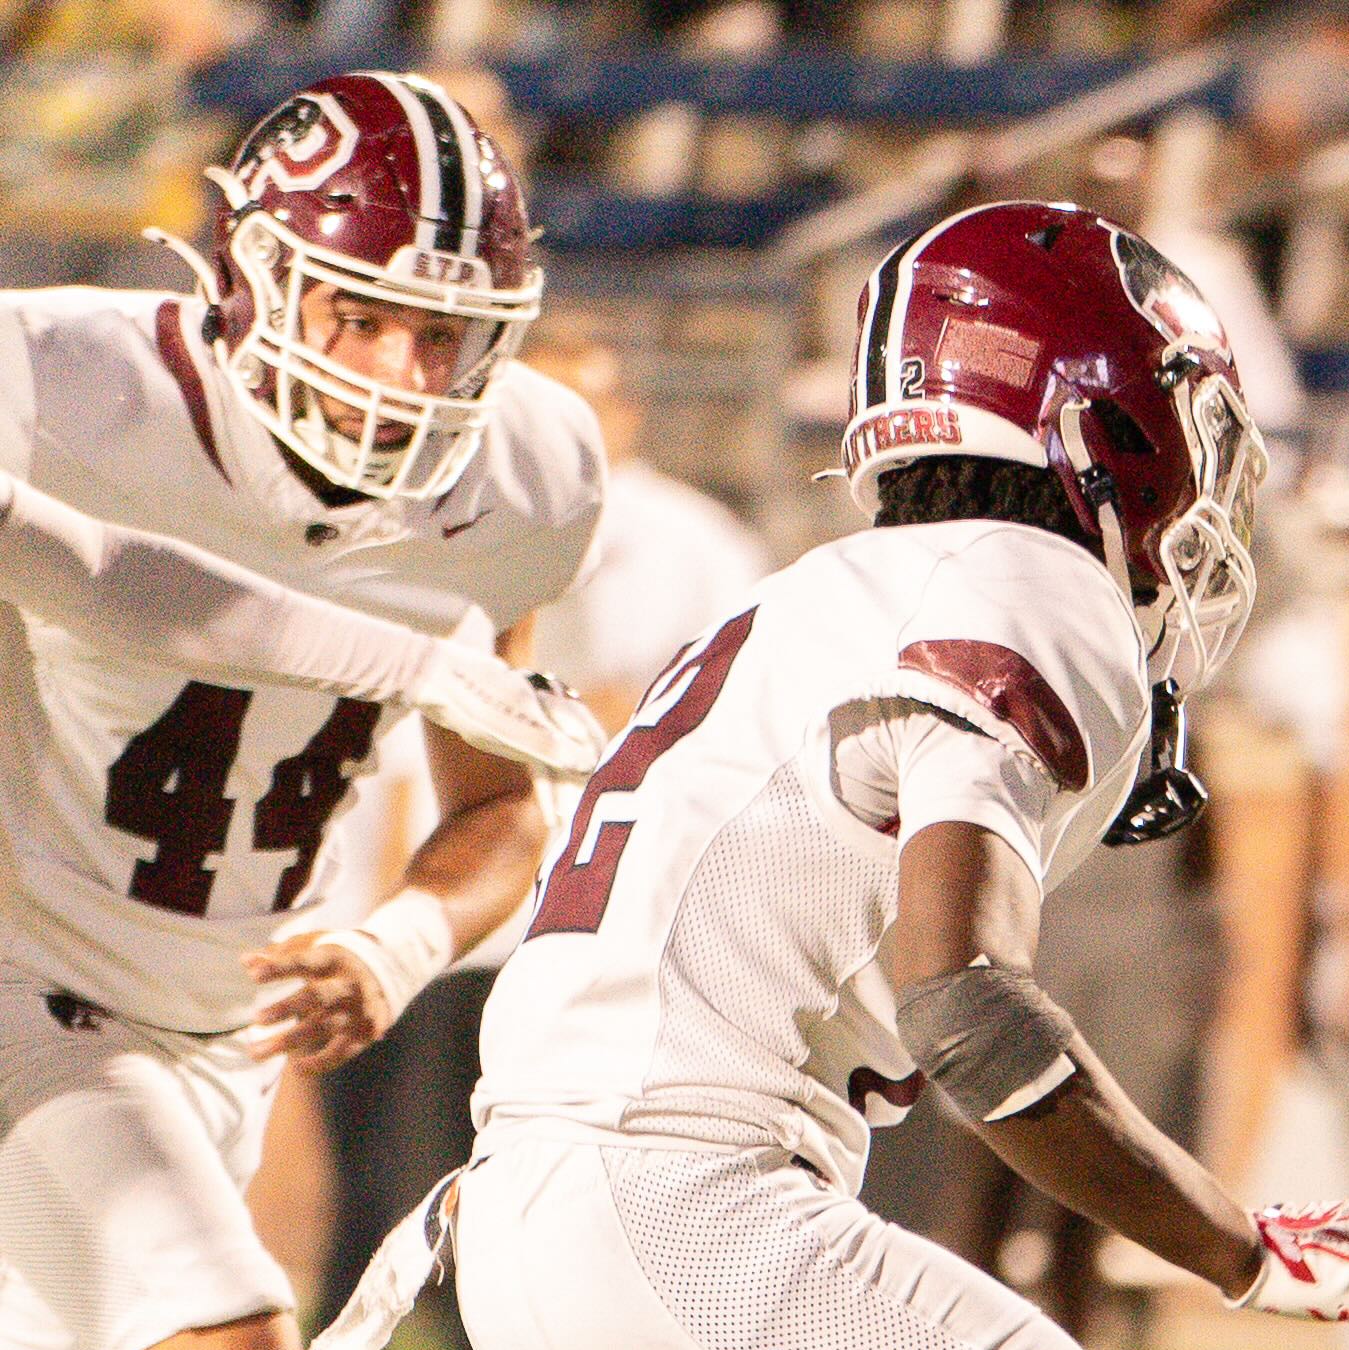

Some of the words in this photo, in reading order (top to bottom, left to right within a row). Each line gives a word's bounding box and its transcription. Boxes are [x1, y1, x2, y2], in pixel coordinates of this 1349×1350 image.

[900, 357, 926, 401] 2
[105, 678, 384, 918] 44
[524, 603, 760, 943] 2
